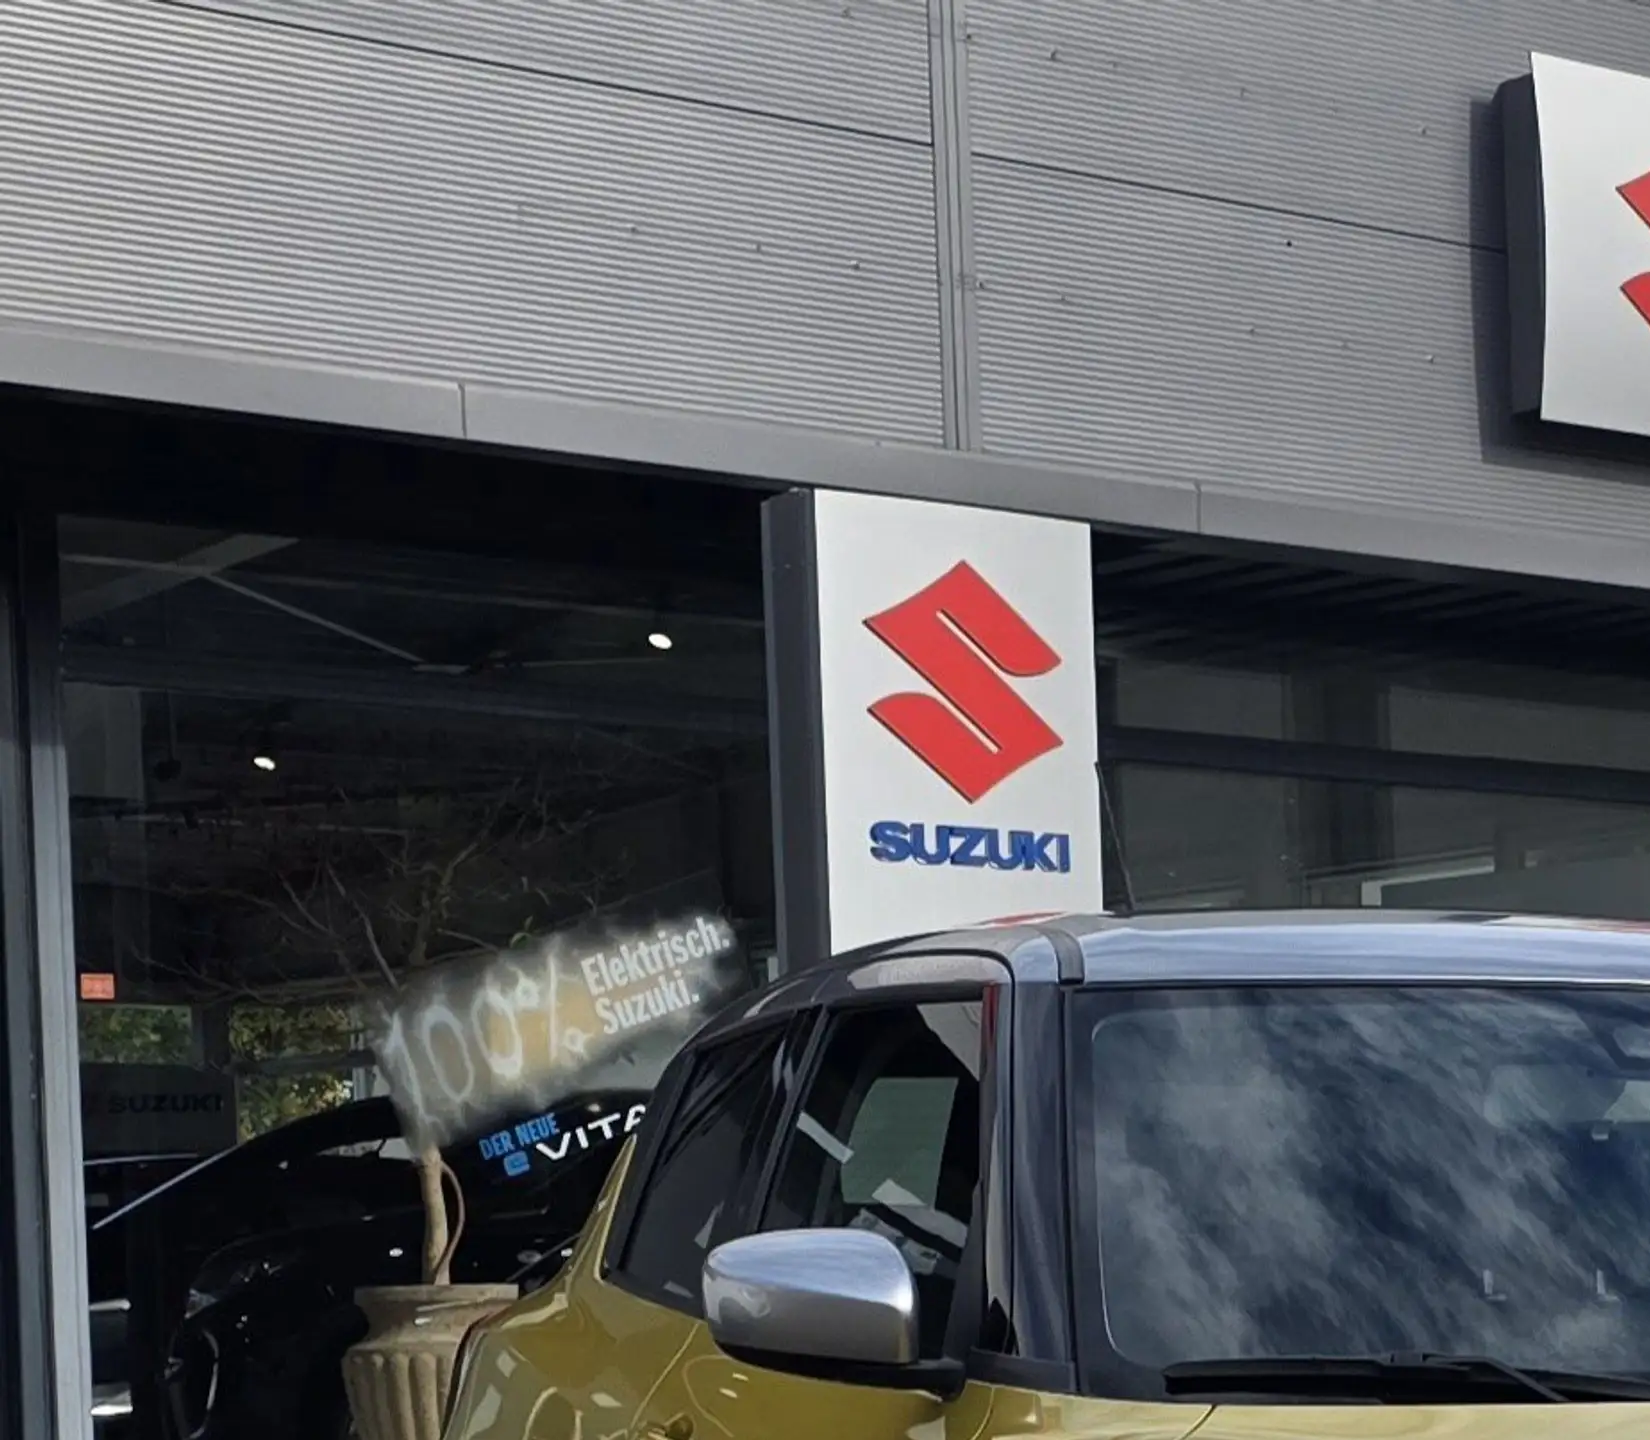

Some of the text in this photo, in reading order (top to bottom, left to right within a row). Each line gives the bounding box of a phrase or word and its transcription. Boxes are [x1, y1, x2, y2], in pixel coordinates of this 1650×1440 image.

[869, 820, 1071, 873] SUZUKI
[581, 917, 730, 995] Elektrisch.
[594, 970, 699, 1035] Suzuki.
[108, 1093, 222, 1114] SUZUKI
[479, 1113, 560, 1160] DER NEUE
